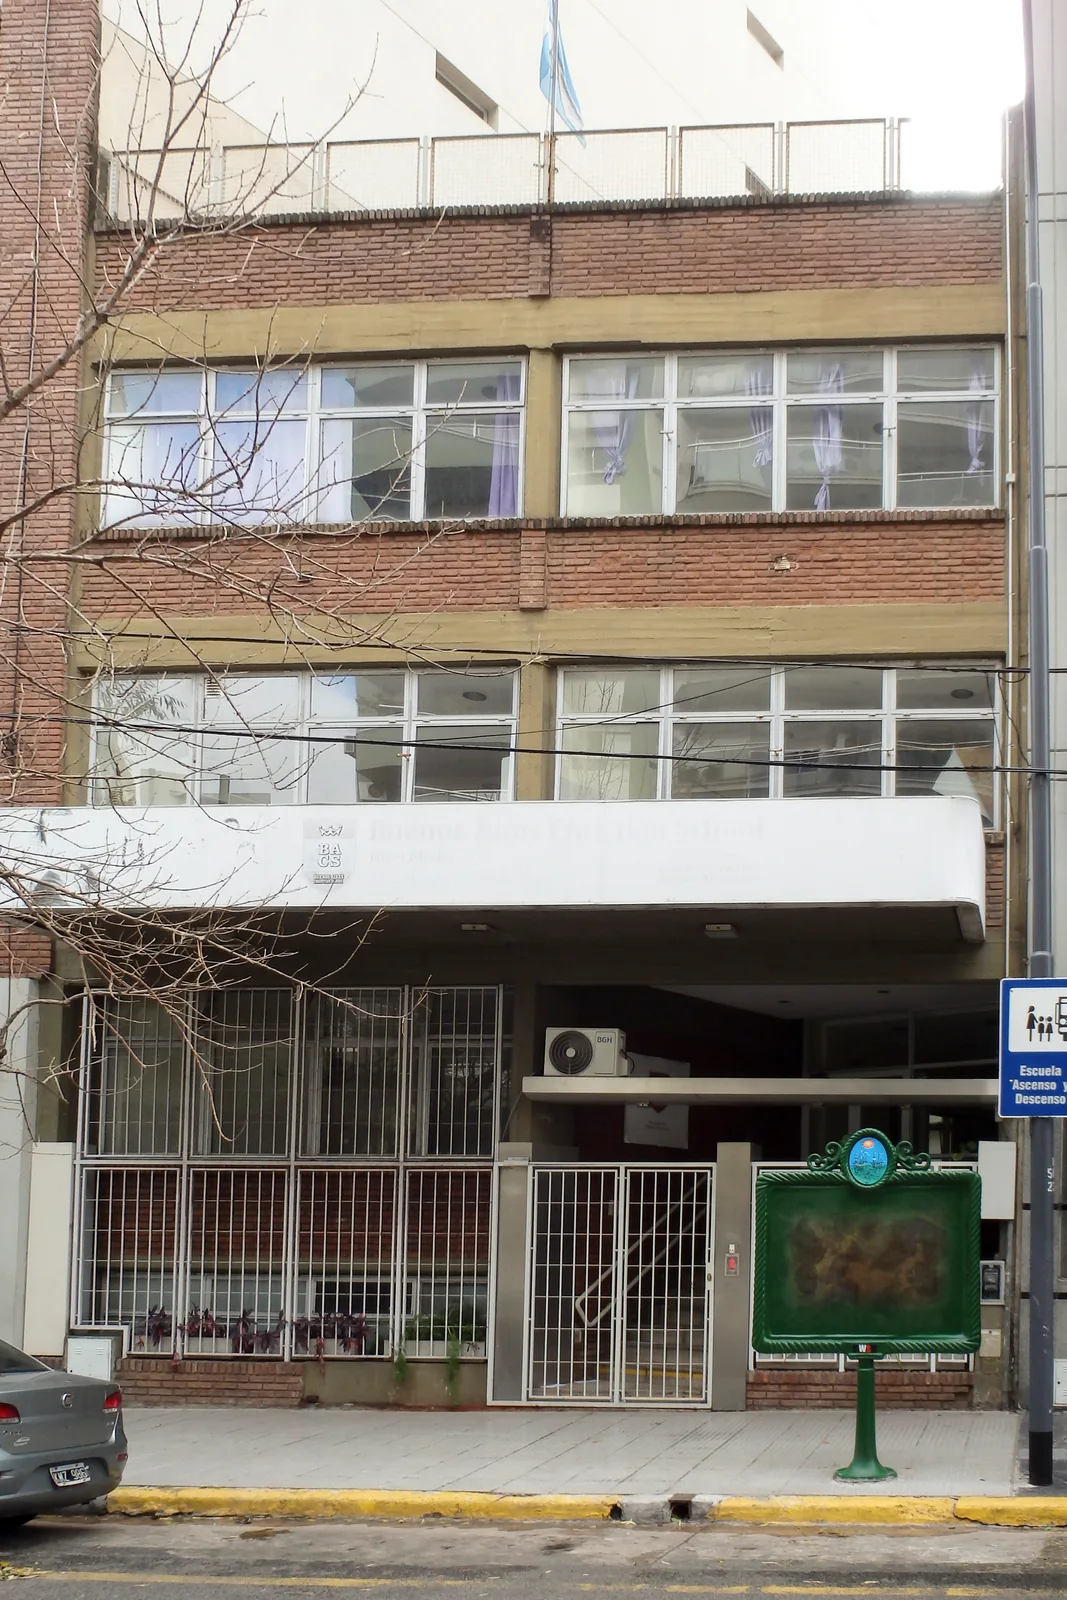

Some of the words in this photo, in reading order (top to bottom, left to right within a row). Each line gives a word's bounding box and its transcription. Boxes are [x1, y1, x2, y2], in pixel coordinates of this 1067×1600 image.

[318, 843, 342, 855] BA
[318, 855, 341, 867] CS
[1019, 1065, 1062, 1076] Escuela
[1012, 1079, 1057, 1090] Ascenso
[1015, 1093, 1066, 1104] Descenso
